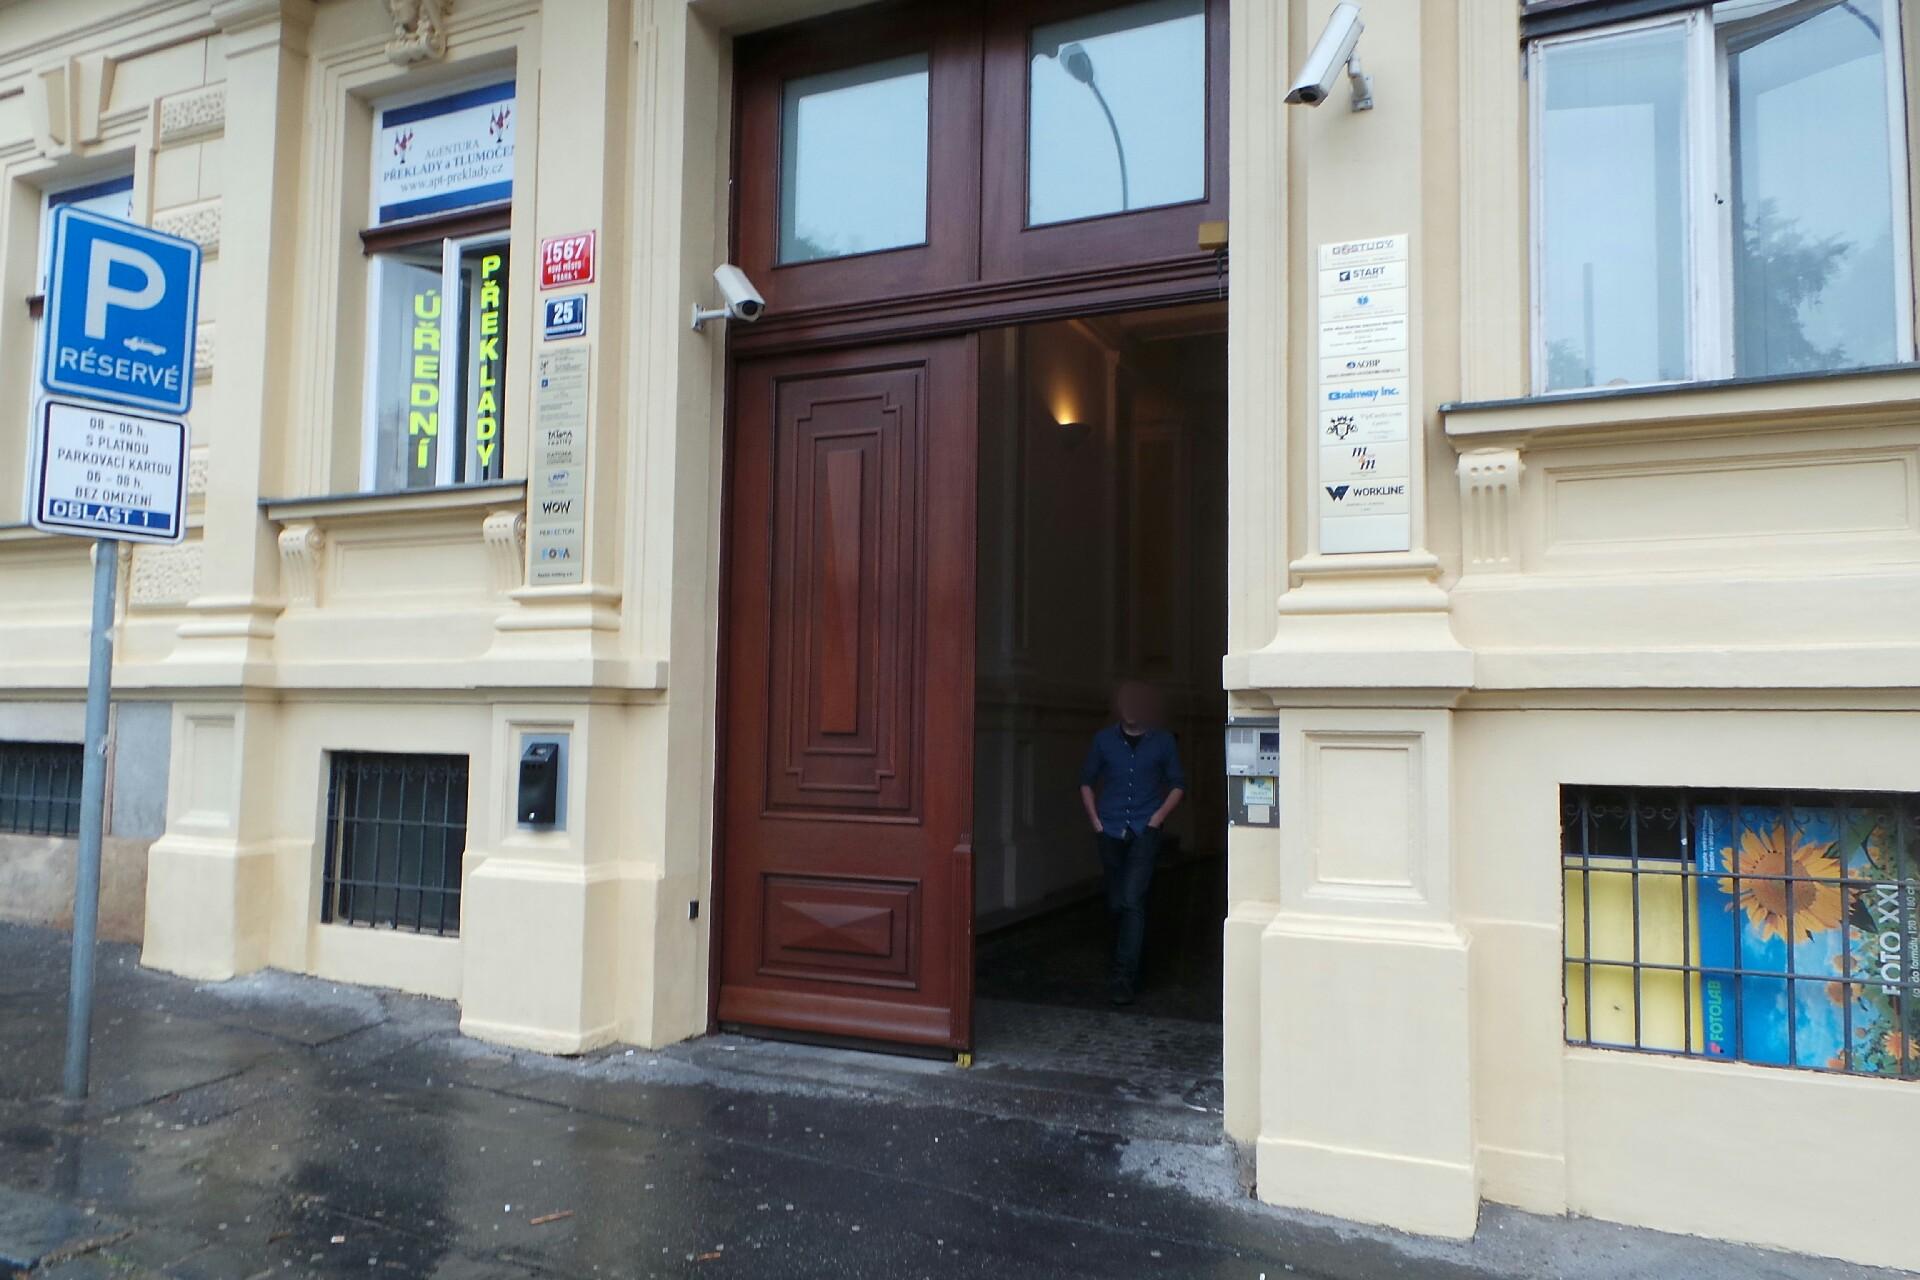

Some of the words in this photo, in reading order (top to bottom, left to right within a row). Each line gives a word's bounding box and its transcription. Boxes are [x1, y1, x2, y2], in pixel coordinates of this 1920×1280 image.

[425, 138, 480, 160] AGENTURA
[444, 162, 451, 170] a
[545, 236, 587, 266] 1567
[1352, 266, 1386, 280] START
[85, 238, 167, 340] P
[553, 301, 574, 326] 25
[60, 346, 181, 392] RÉSERVÉ
[477, 255, 501, 468] PŘEKLADY
[409, 289, 442, 469] ÚŘEDNÍ
[97, 438, 149, 456] PLATNOU
[58, 448, 125, 468] PARKOVACÍ
[129, 459, 173, 477] KARTOU
[75, 485, 98, 500] BEZ
[102, 490, 153, 507] OMEZENÍ
[1352, 485, 1406, 498] WORKLINE
[52, 500, 134, 526] OBLAST
[141, 511, 150, 527] 1
[542, 499, 572, 516] WOW
[1879, 931, 1902, 997] FOTO
[1707, 979, 1724, 1042] FOTOLAB
